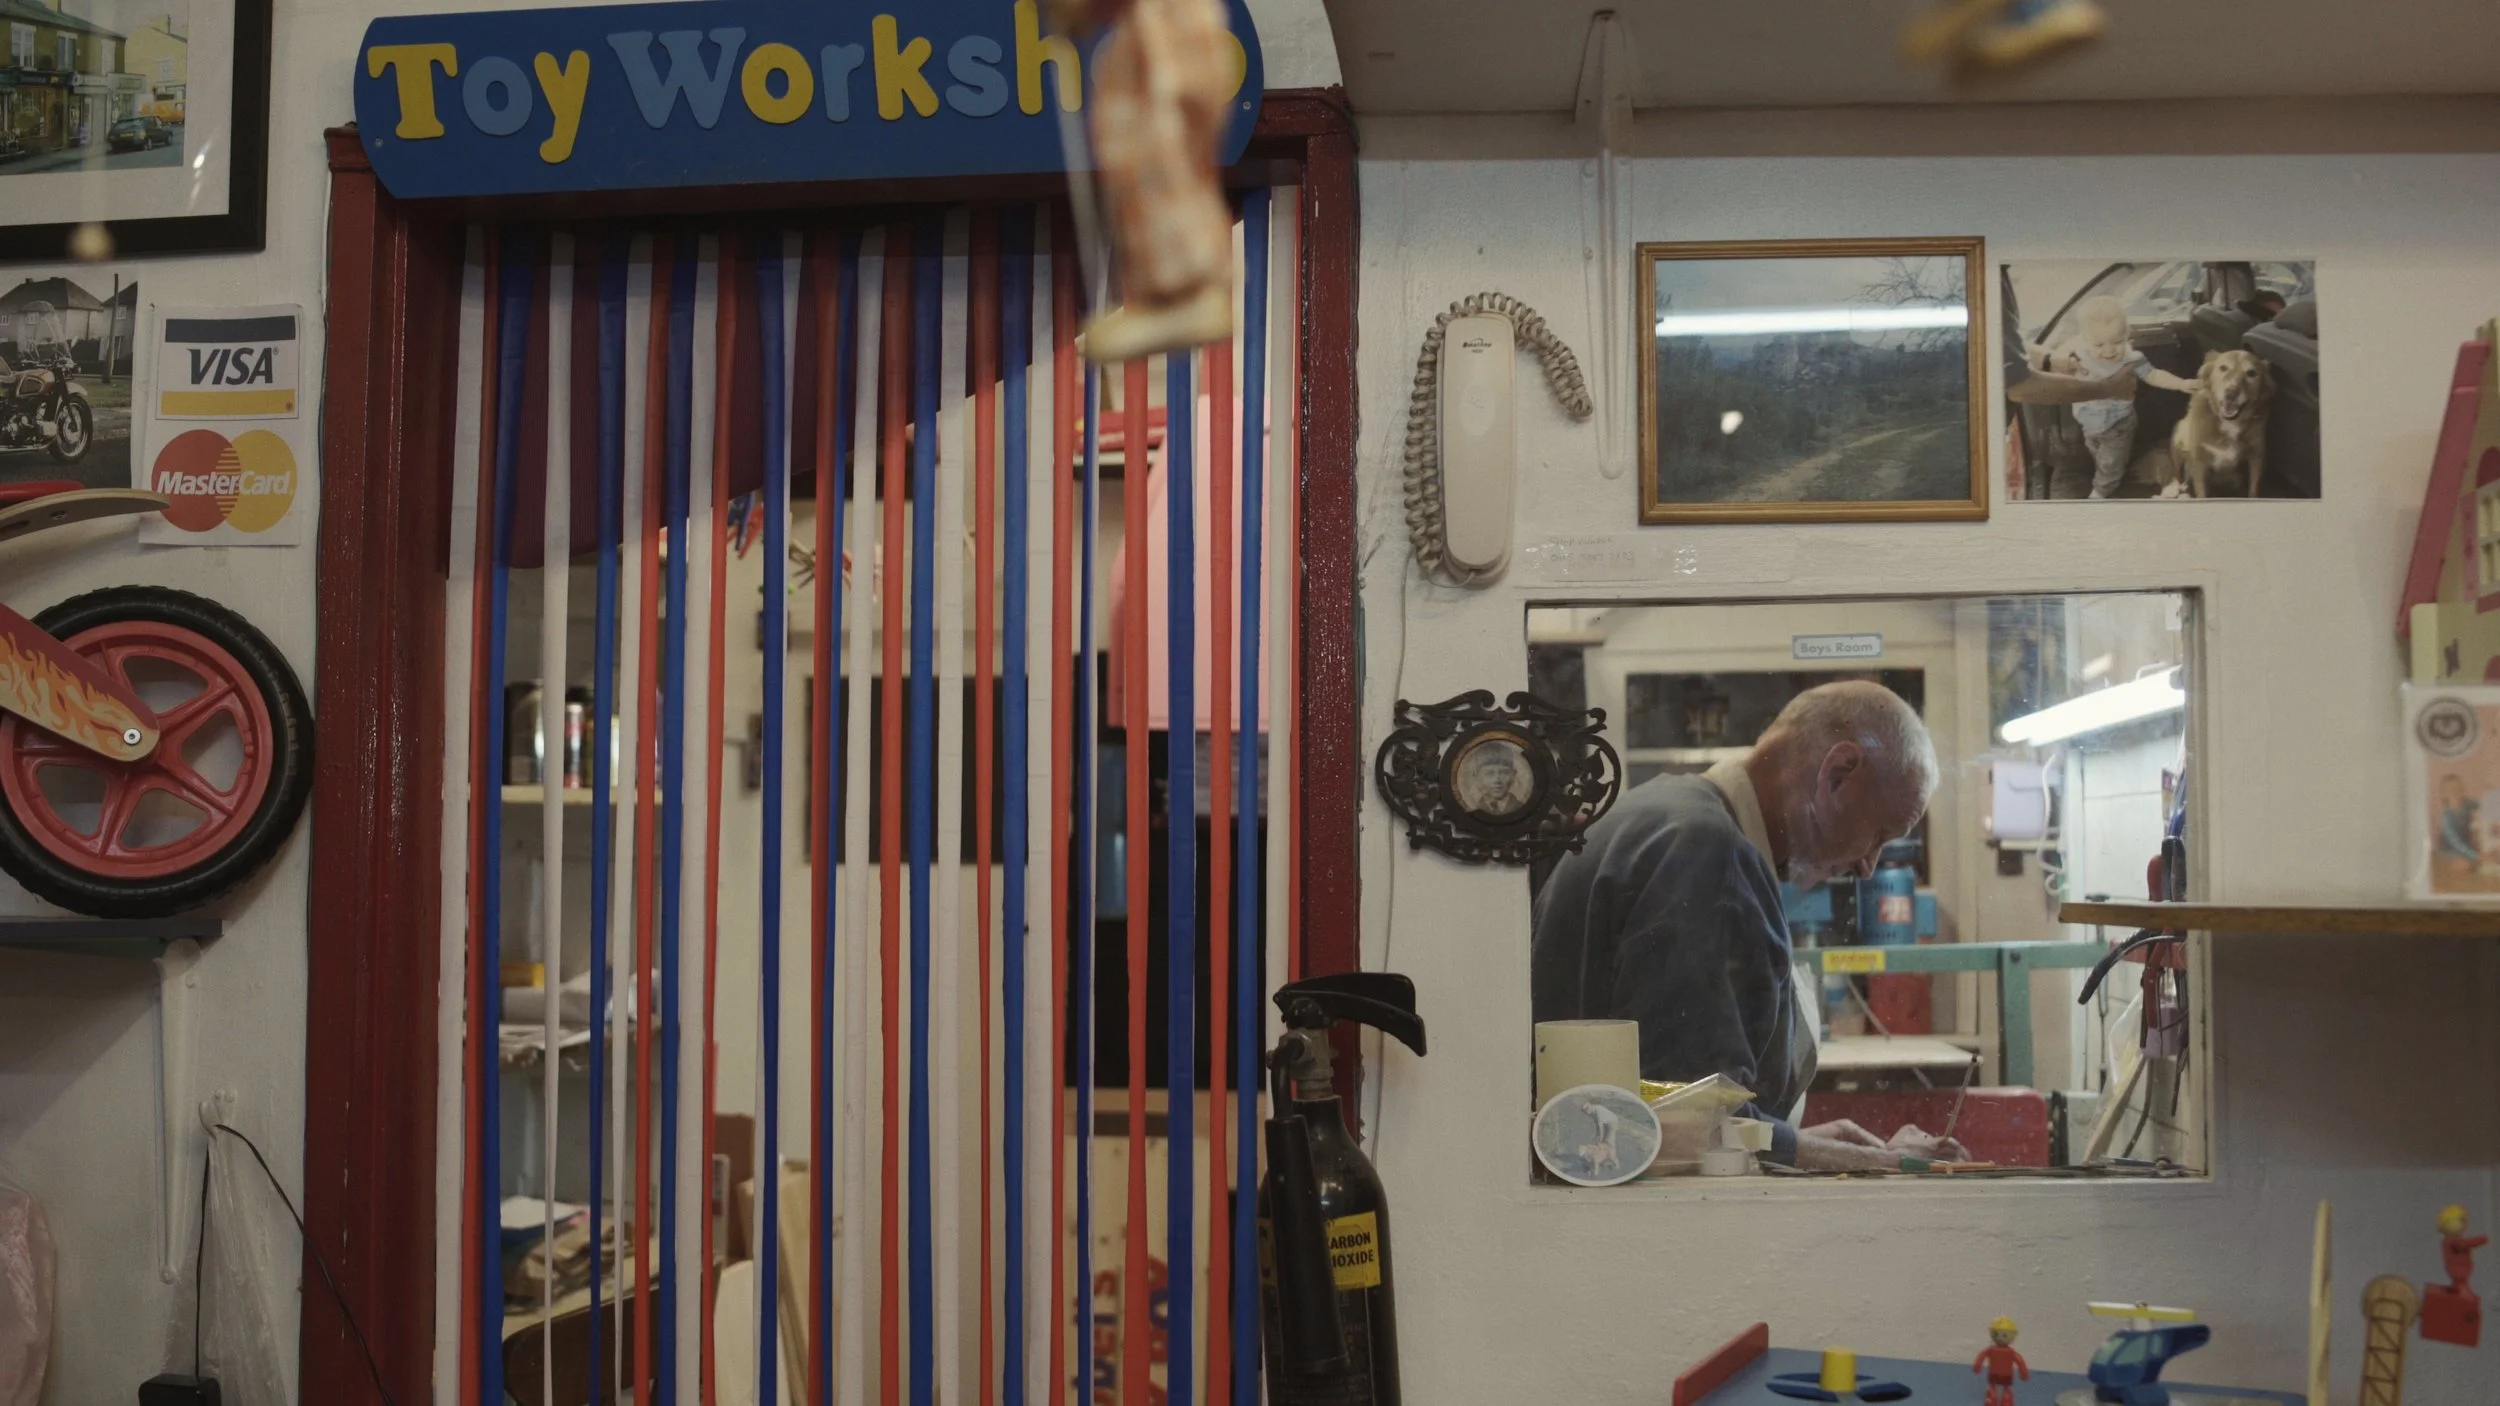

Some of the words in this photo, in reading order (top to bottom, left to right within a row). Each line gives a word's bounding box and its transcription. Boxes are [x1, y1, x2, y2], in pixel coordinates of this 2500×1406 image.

[367, 43, 590, 164] Toy
[606, 0, 1247, 130] Worksh
[187, 347, 274, 386] VISA
[157, 470, 292, 496] MasterCard
[1800, 643, 1832, 655] Boys
[1835, 641, 1873, 652] Room
[1331, 1249, 1374, 1268] IOXIDE
